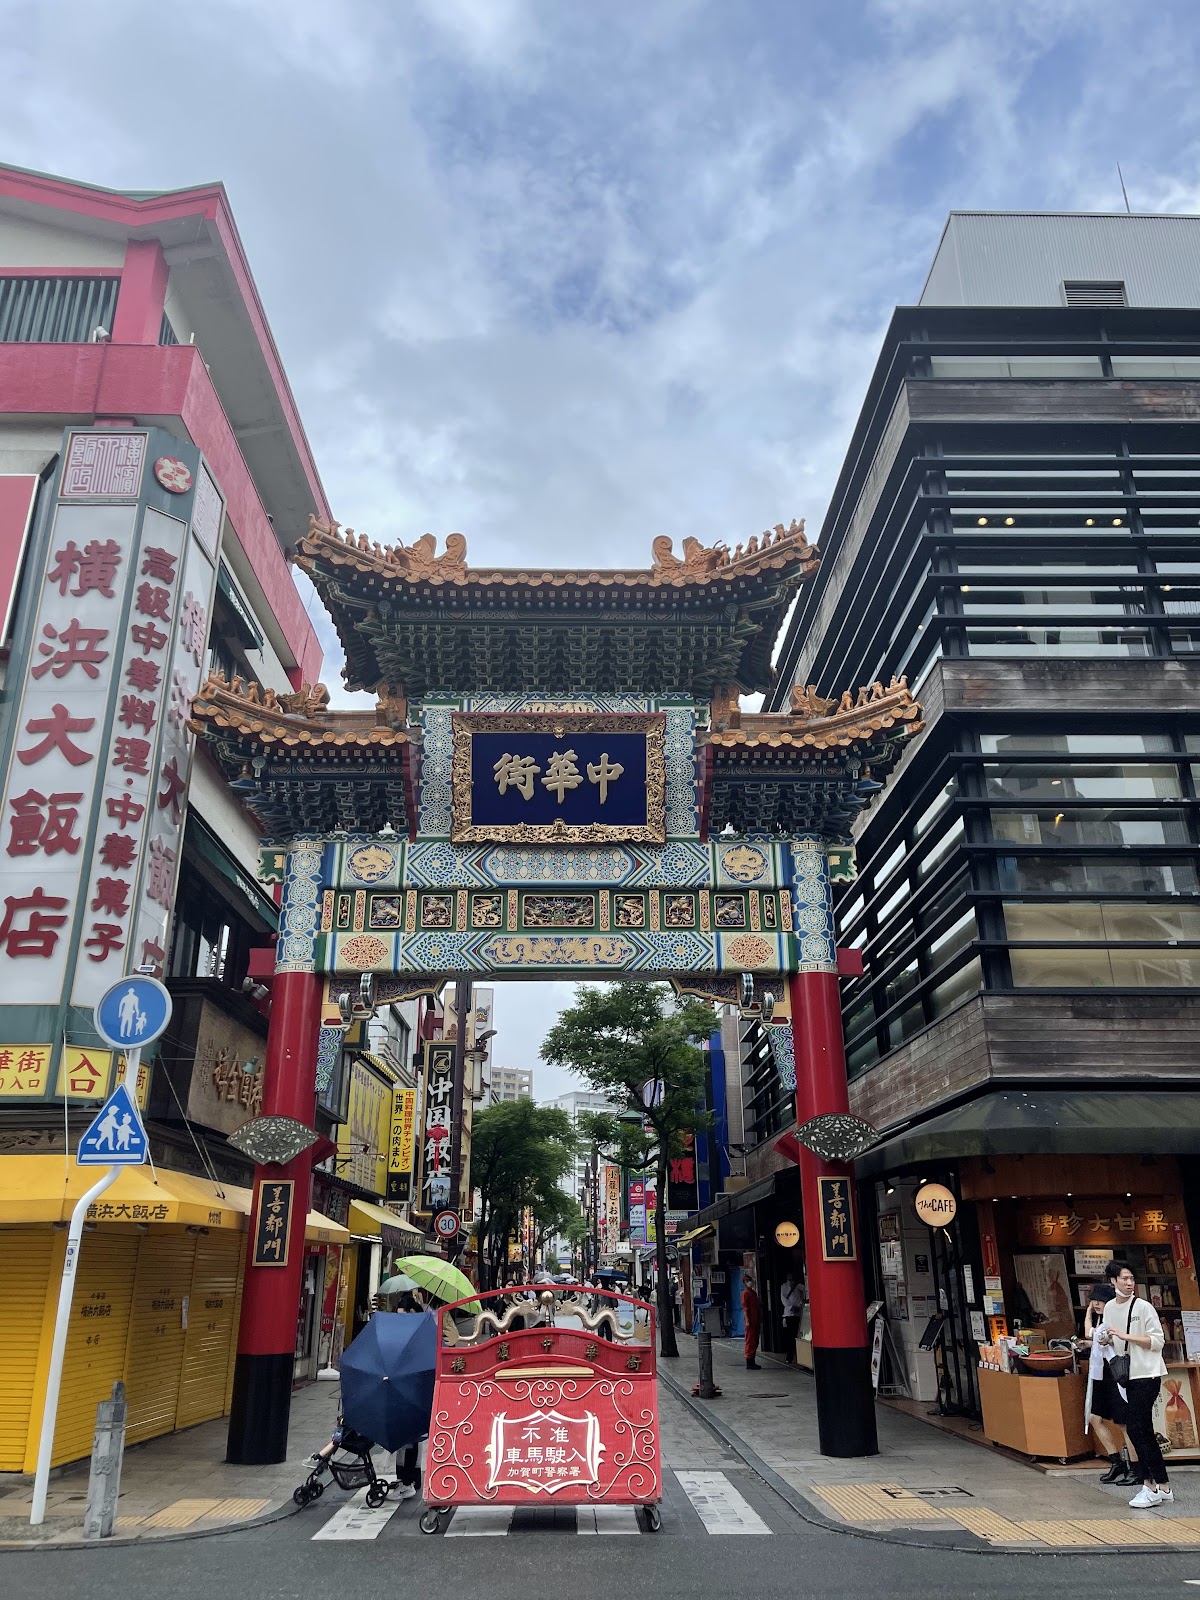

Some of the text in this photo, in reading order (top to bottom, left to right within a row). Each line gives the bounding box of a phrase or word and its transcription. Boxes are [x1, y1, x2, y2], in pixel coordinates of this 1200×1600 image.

[0, 538, 121, 958] 横浜大飯店
[493, 749, 624, 804] 中華街
[67, 1053, 102, 1093] 入口
[117, 1060, 146, 1090] 中街
[390, 1094, 404, 1168] 世界一の肉まん
[401, 1091, 414, 1171] 中国料理世界チャンピオン
[931, 1199, 954, 1212] CAFE
[440, 1219, 454, 1231] 30
[504, 1447, 586, 1464] 車馬駛入
[507, 1466, 581, 1477] 加賀町警察署
